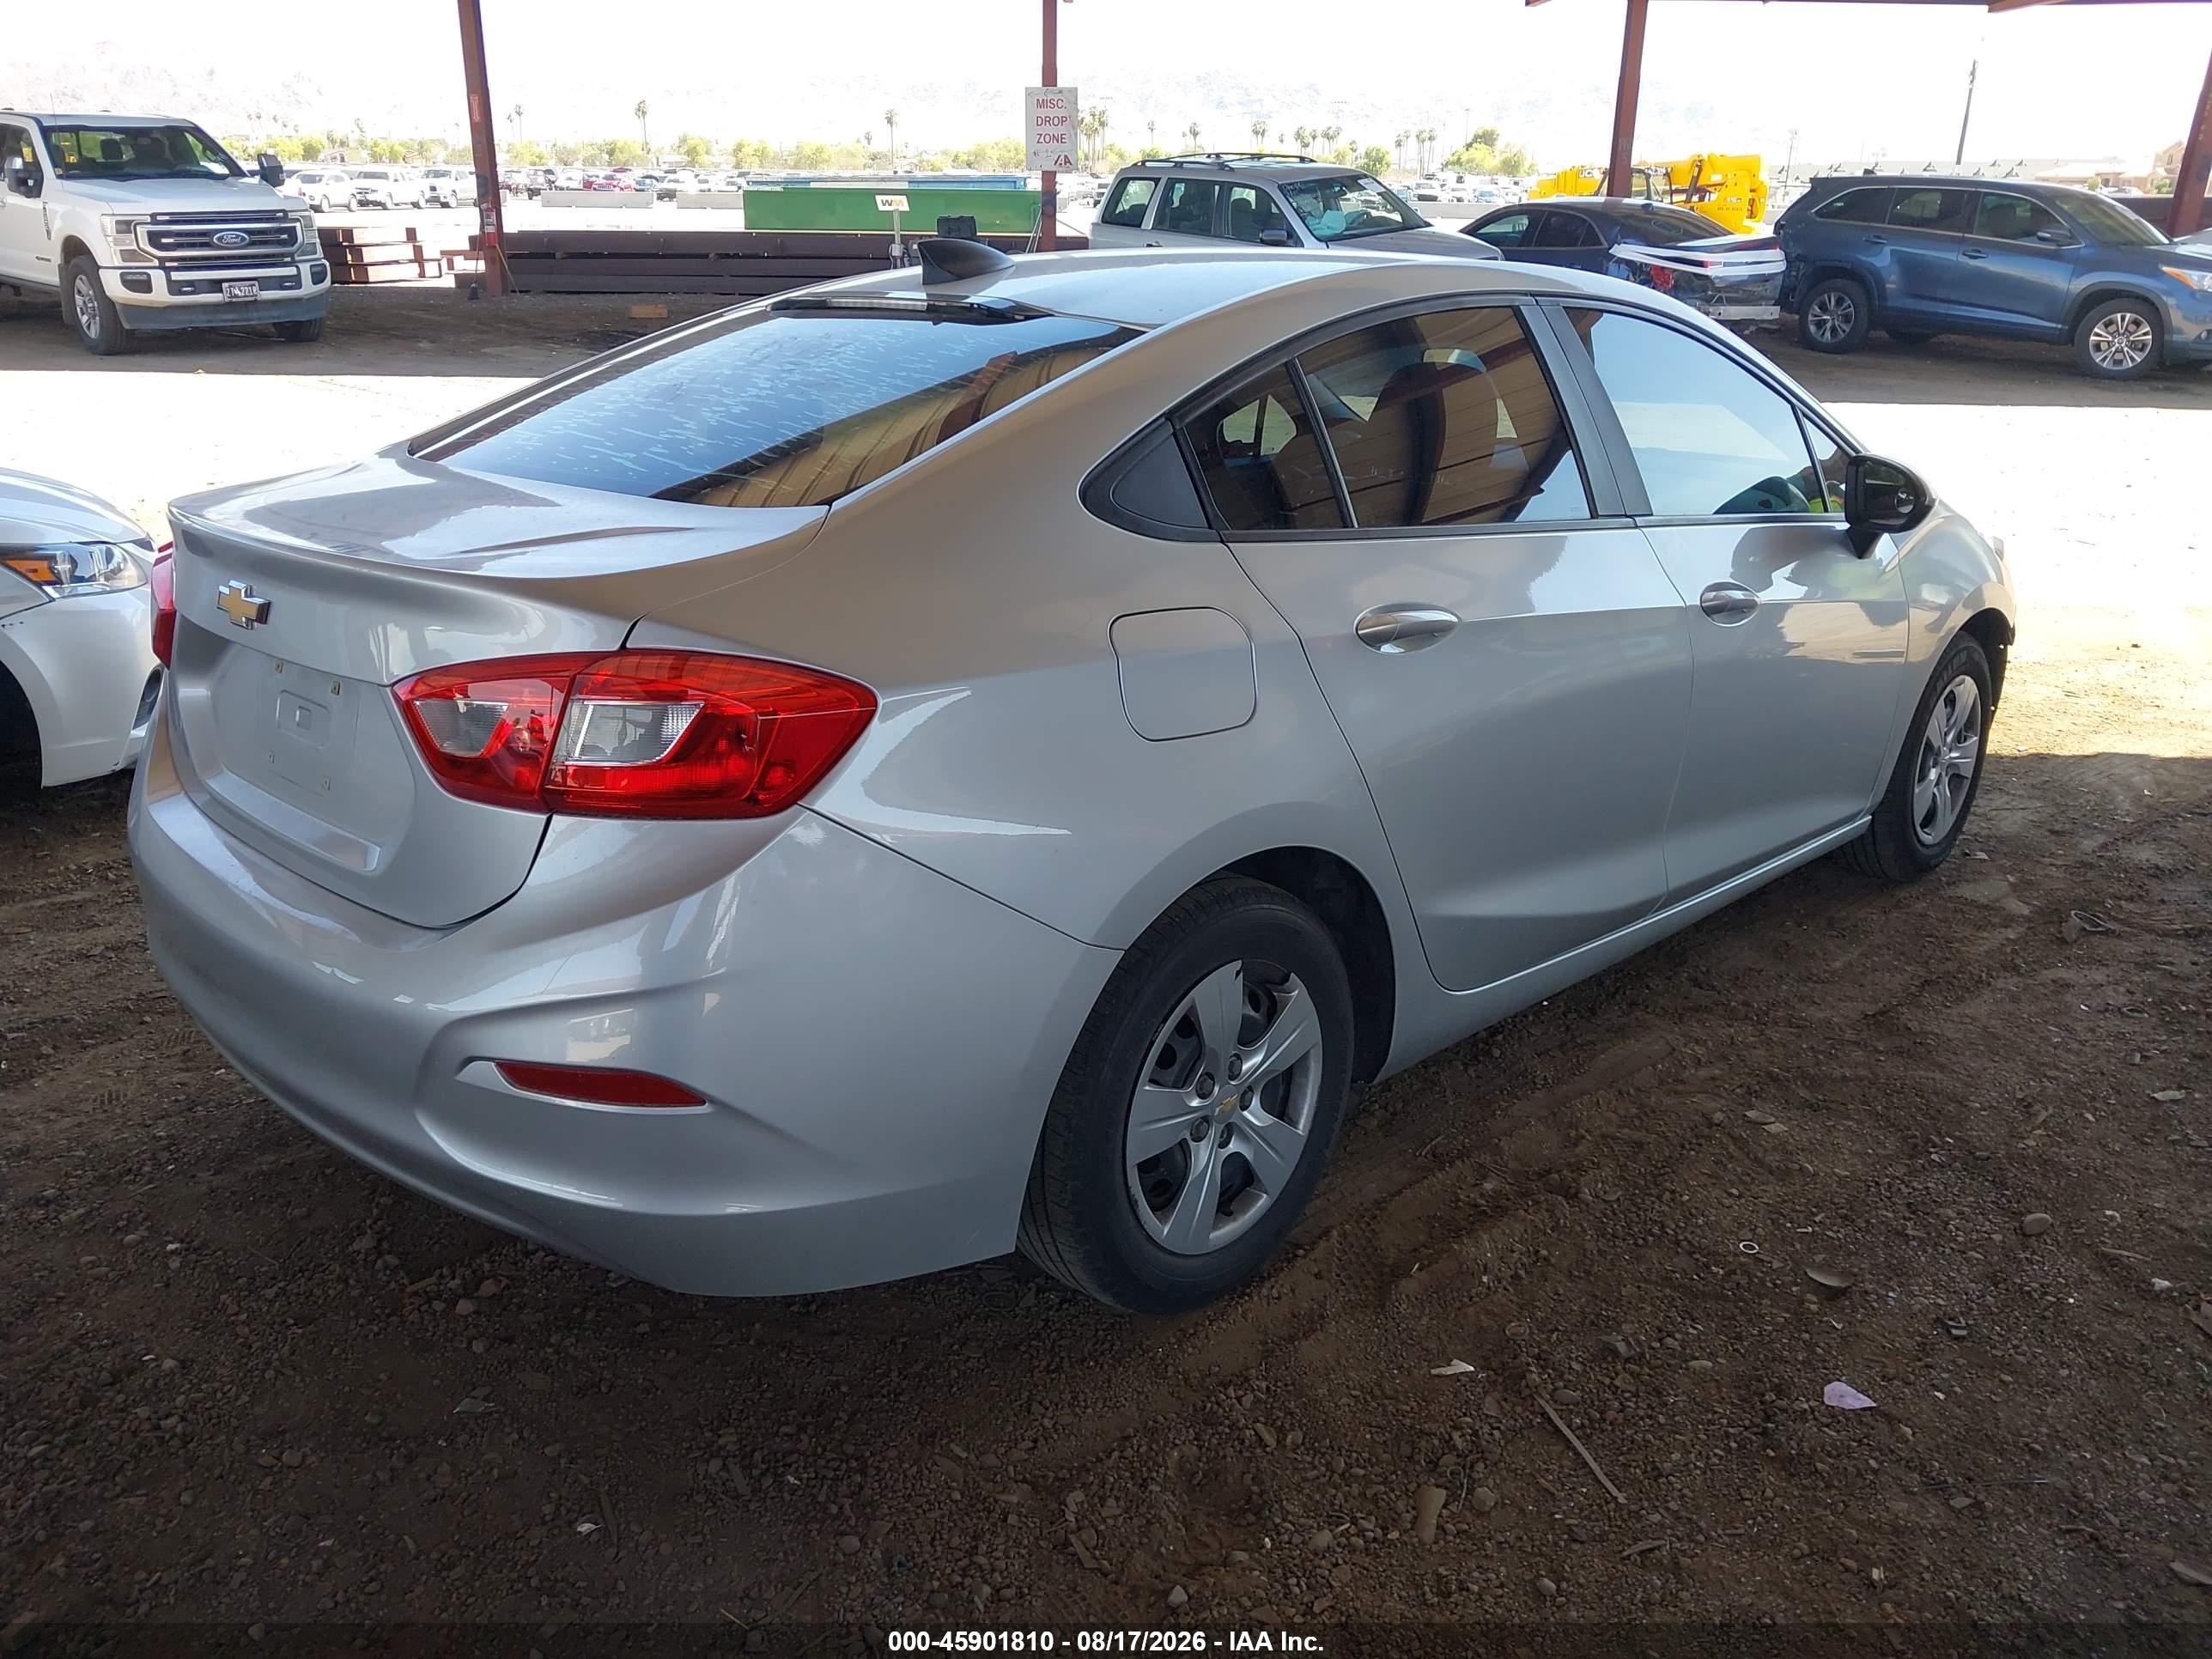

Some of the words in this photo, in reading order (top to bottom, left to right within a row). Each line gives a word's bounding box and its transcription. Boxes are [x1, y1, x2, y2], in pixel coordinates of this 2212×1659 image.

[1036, 98, 1066, 109] MISC.
[1036, 116, 1067, 126] DROP
[1036, 133, 1066, 144] ZONE
[880, 198, 903, 207] WM
[222, 234, 241, 243] Ford
